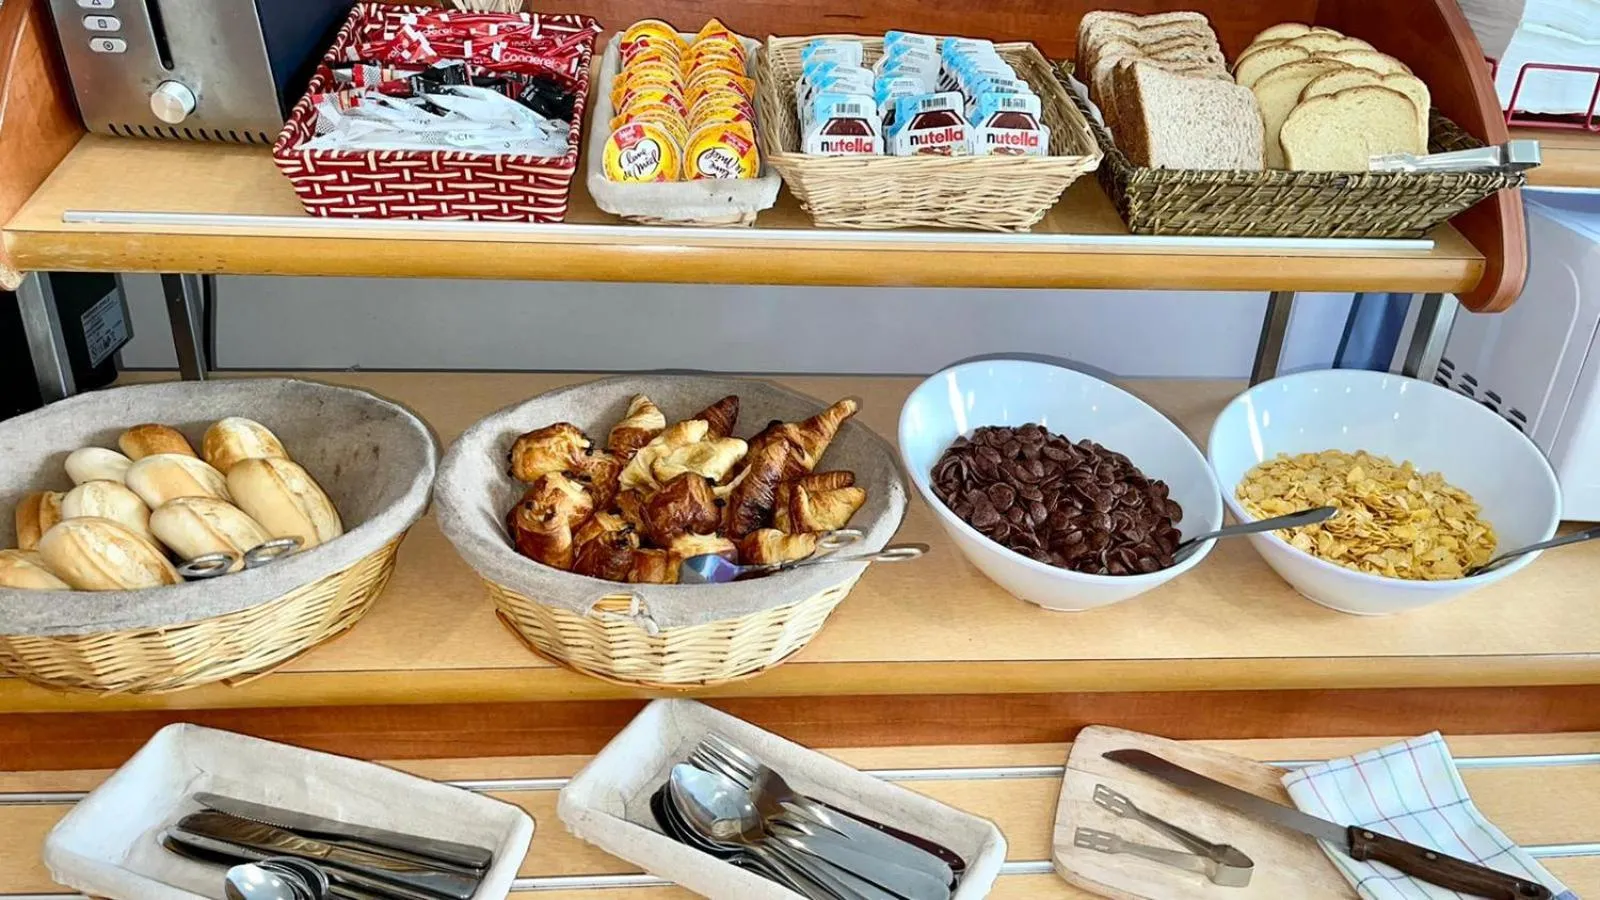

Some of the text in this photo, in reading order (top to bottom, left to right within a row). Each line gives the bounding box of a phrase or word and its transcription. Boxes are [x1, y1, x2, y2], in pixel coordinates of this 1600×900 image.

[910, 128, 964, 145] nutella
[986, 131, 1039, 147] nutella
[821, 138, 873, 153] nutella
